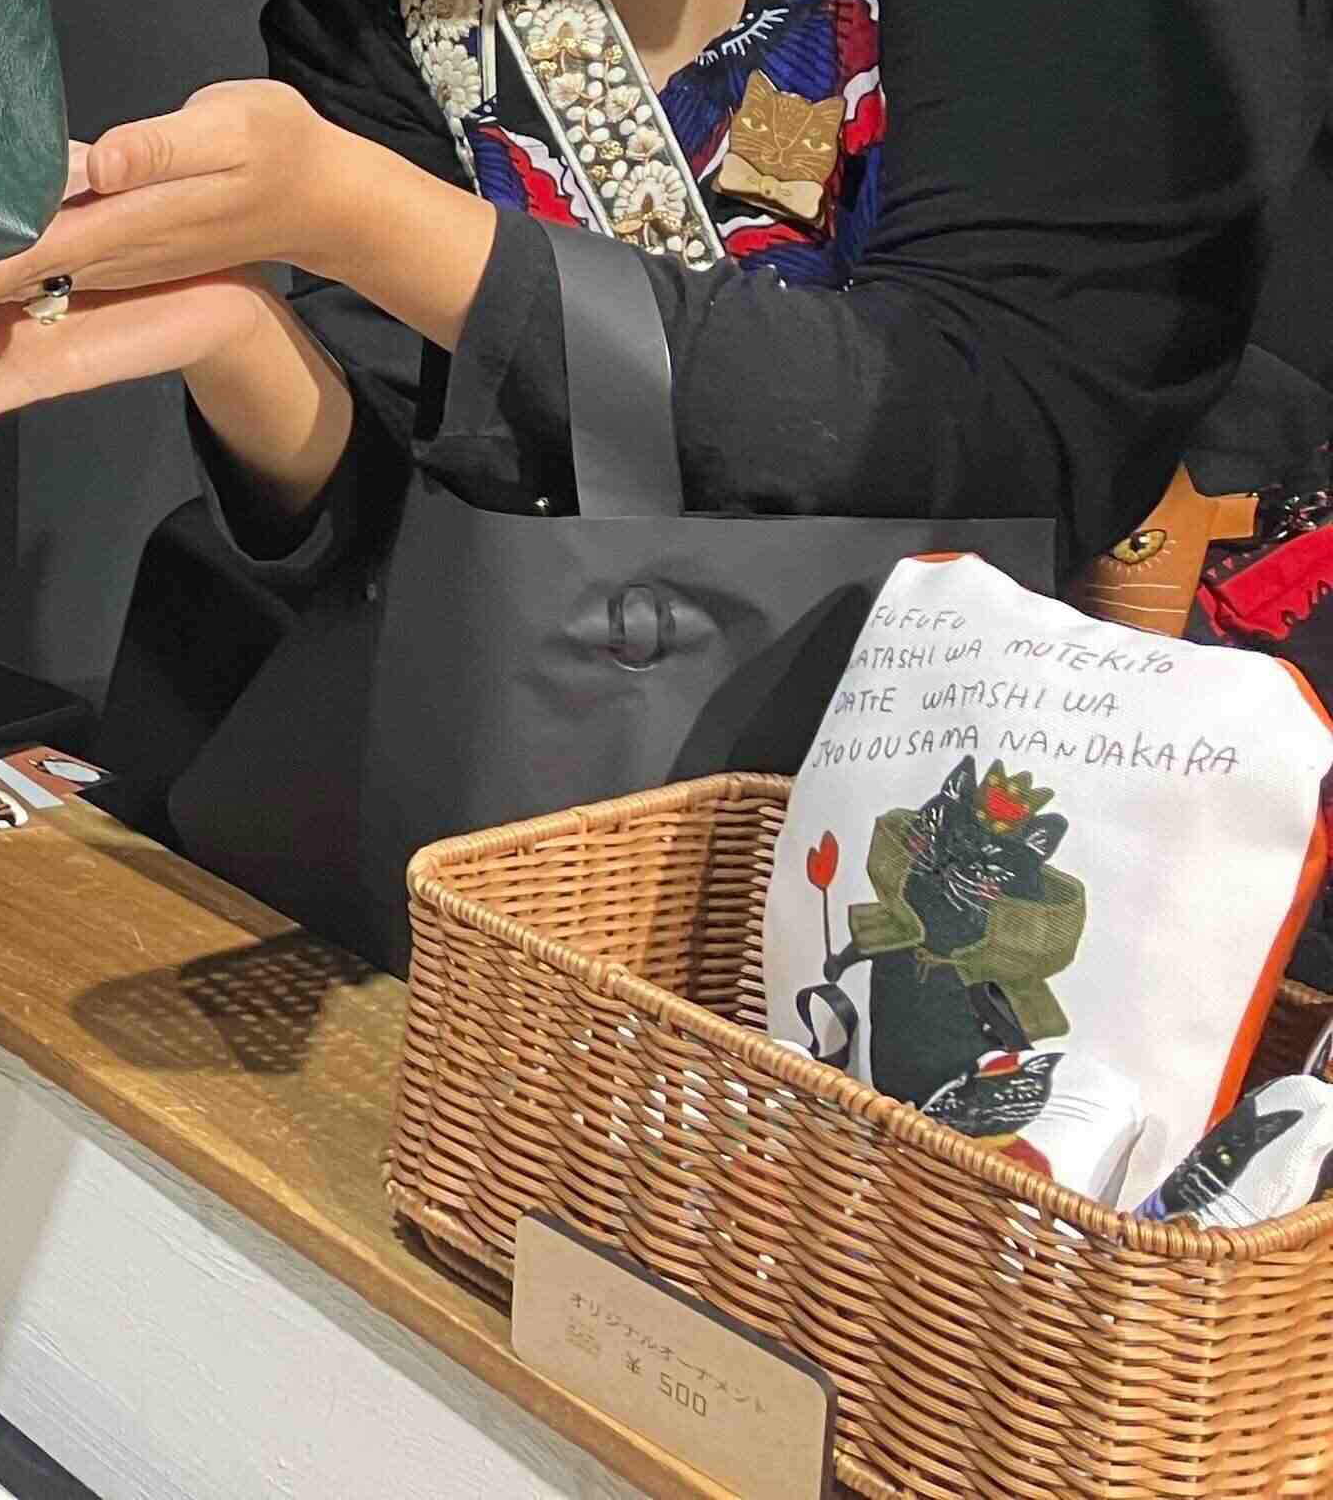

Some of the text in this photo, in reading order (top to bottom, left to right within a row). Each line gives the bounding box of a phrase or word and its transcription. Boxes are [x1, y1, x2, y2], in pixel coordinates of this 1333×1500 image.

[870, 605, 966, 630] FUFUFU
[848, 646, 934, 669] ATASHI
[945, 638, 983, 663] WA
[922, 679, 1047, 709] WATASHI
[1063, 690, 1120, 717] WA
